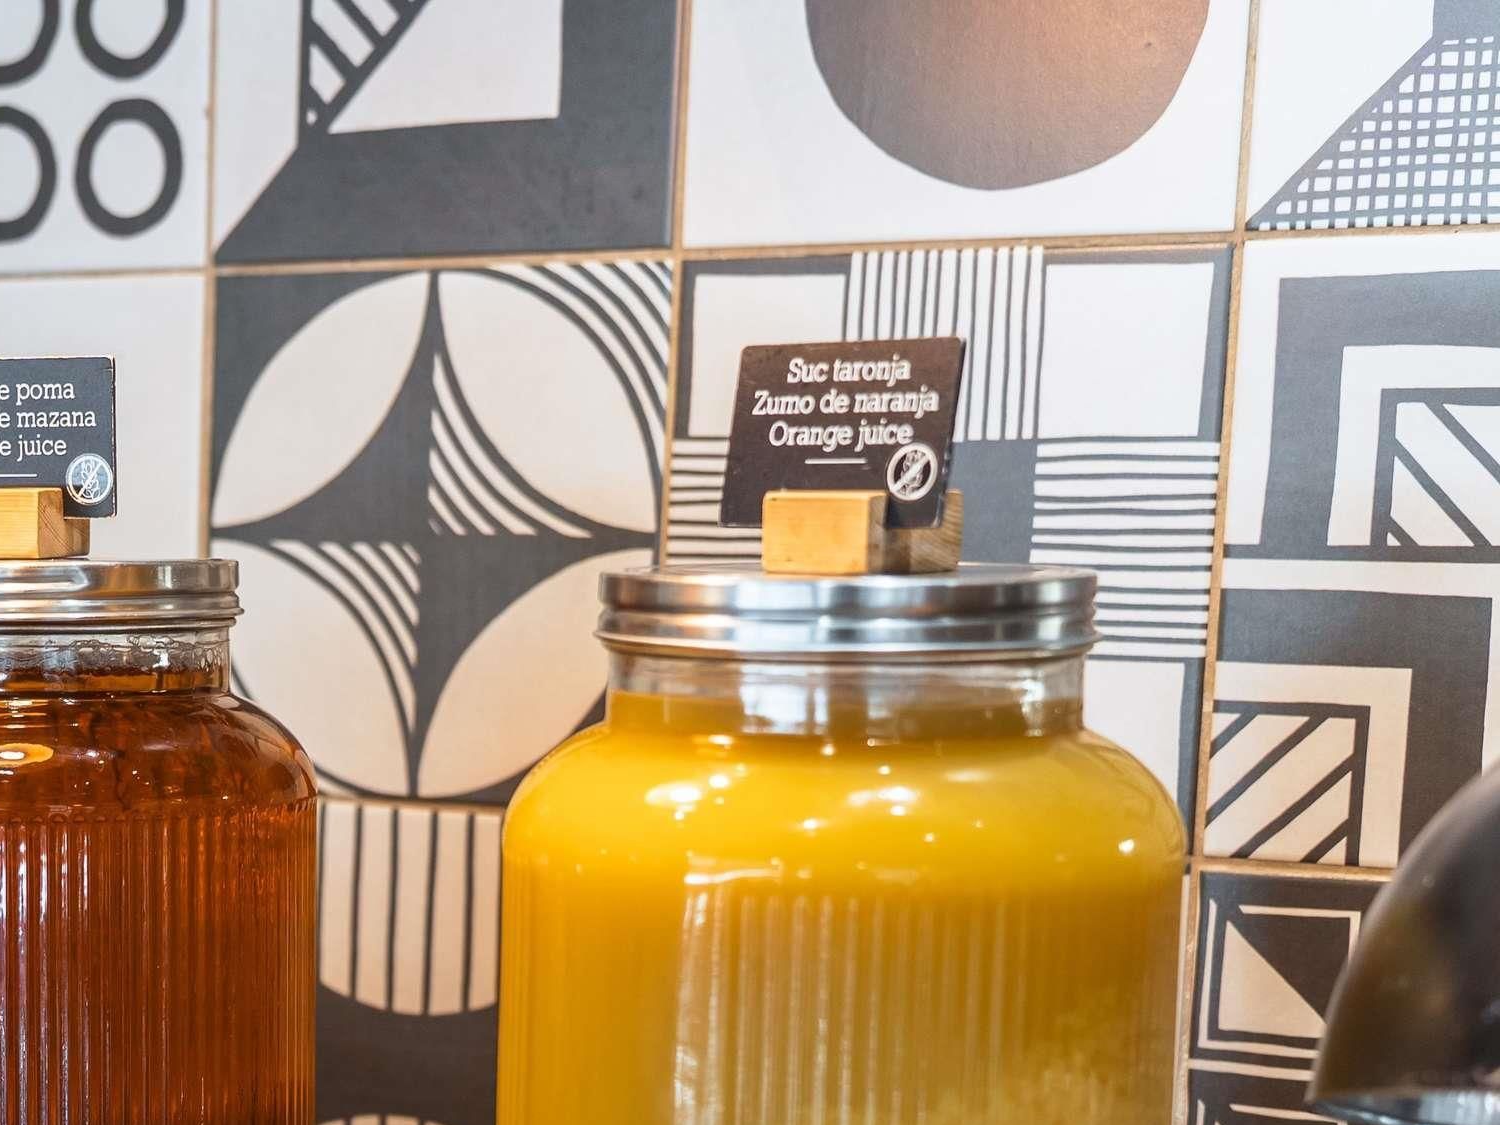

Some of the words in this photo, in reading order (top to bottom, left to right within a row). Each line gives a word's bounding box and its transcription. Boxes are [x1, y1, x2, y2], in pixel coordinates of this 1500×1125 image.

[787, 357, 829, 384] Suc
[833, 353, 912, 387] taronja
[16, 382, 76, 406] poma
[752, 390, 815, 415] Zumo
[819, 388, 850, 414] de
[853, 384, 940, 419] naranja
[17, 409, 97, 428] mazana
[16, 434, 67, 462] juice
[768, 420, 853, 453] Orange
[854, 418, 914, 452] juice
